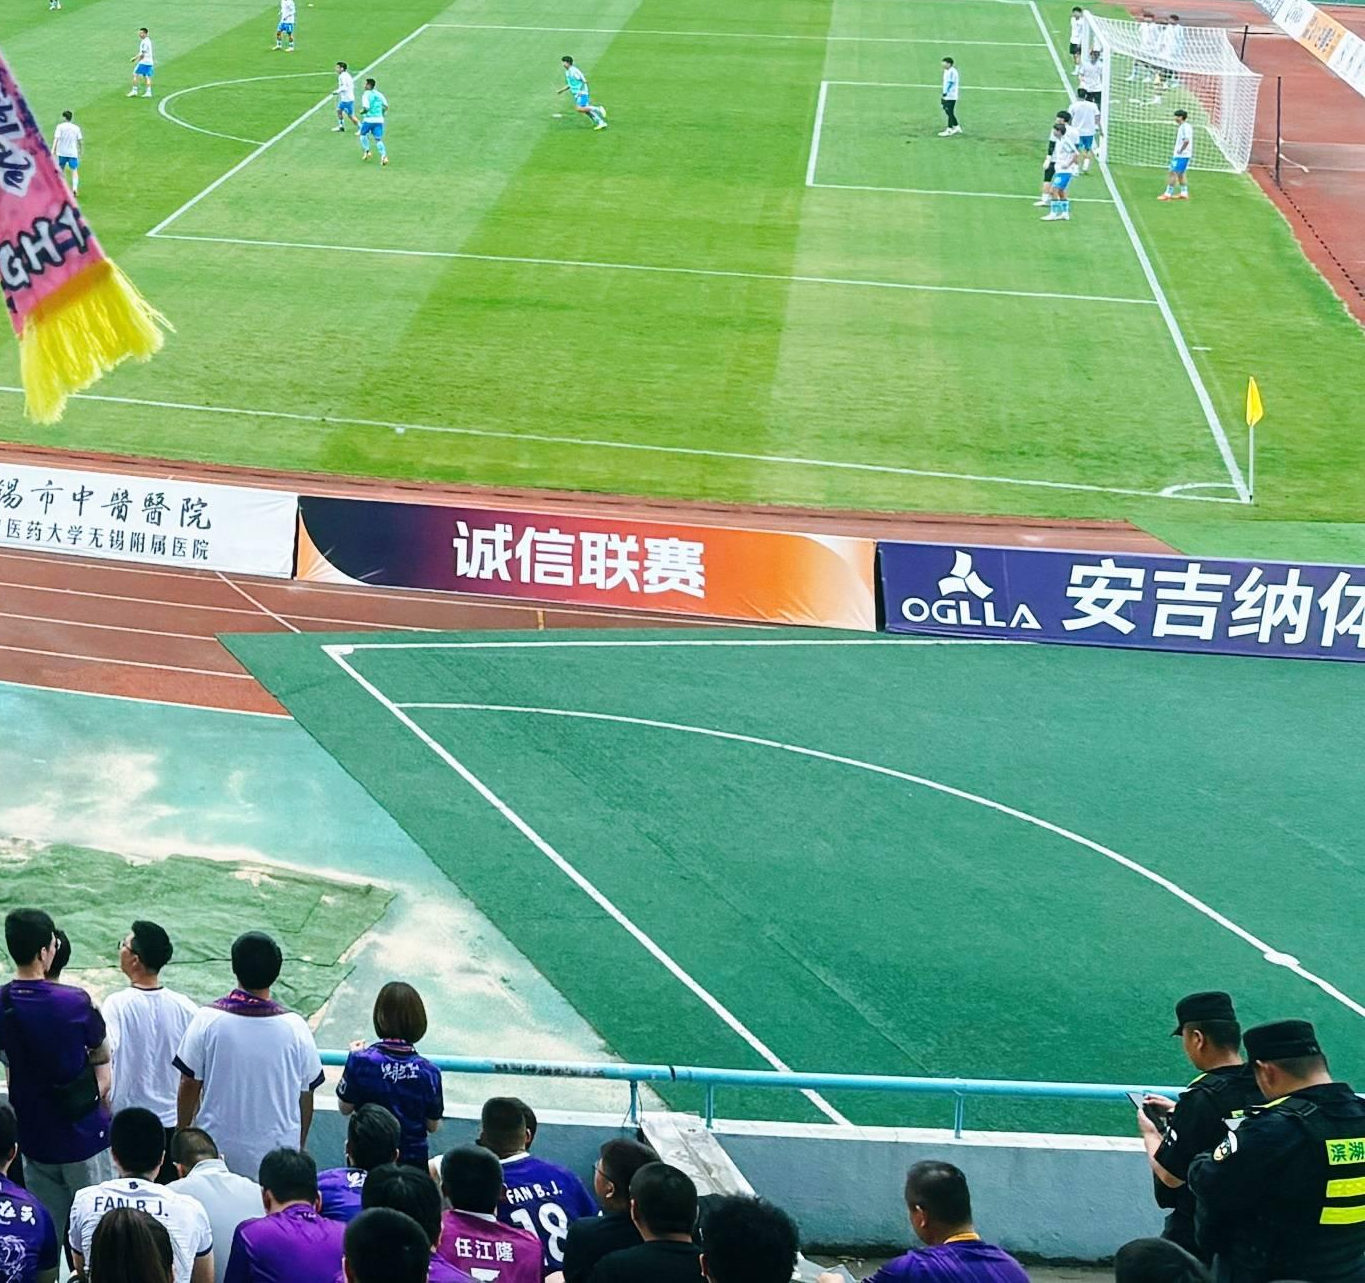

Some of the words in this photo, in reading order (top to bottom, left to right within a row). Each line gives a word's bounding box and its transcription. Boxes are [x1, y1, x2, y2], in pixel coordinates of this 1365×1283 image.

[453, 521, 706, 598] 诚信联赛
[901, 597, 1042, 630] OGLLA
[505, 1187, 534, 1205] FAN
[454, 1236, 515, 1263] 任江隆
[510, 1202, 569, 1266] 18
